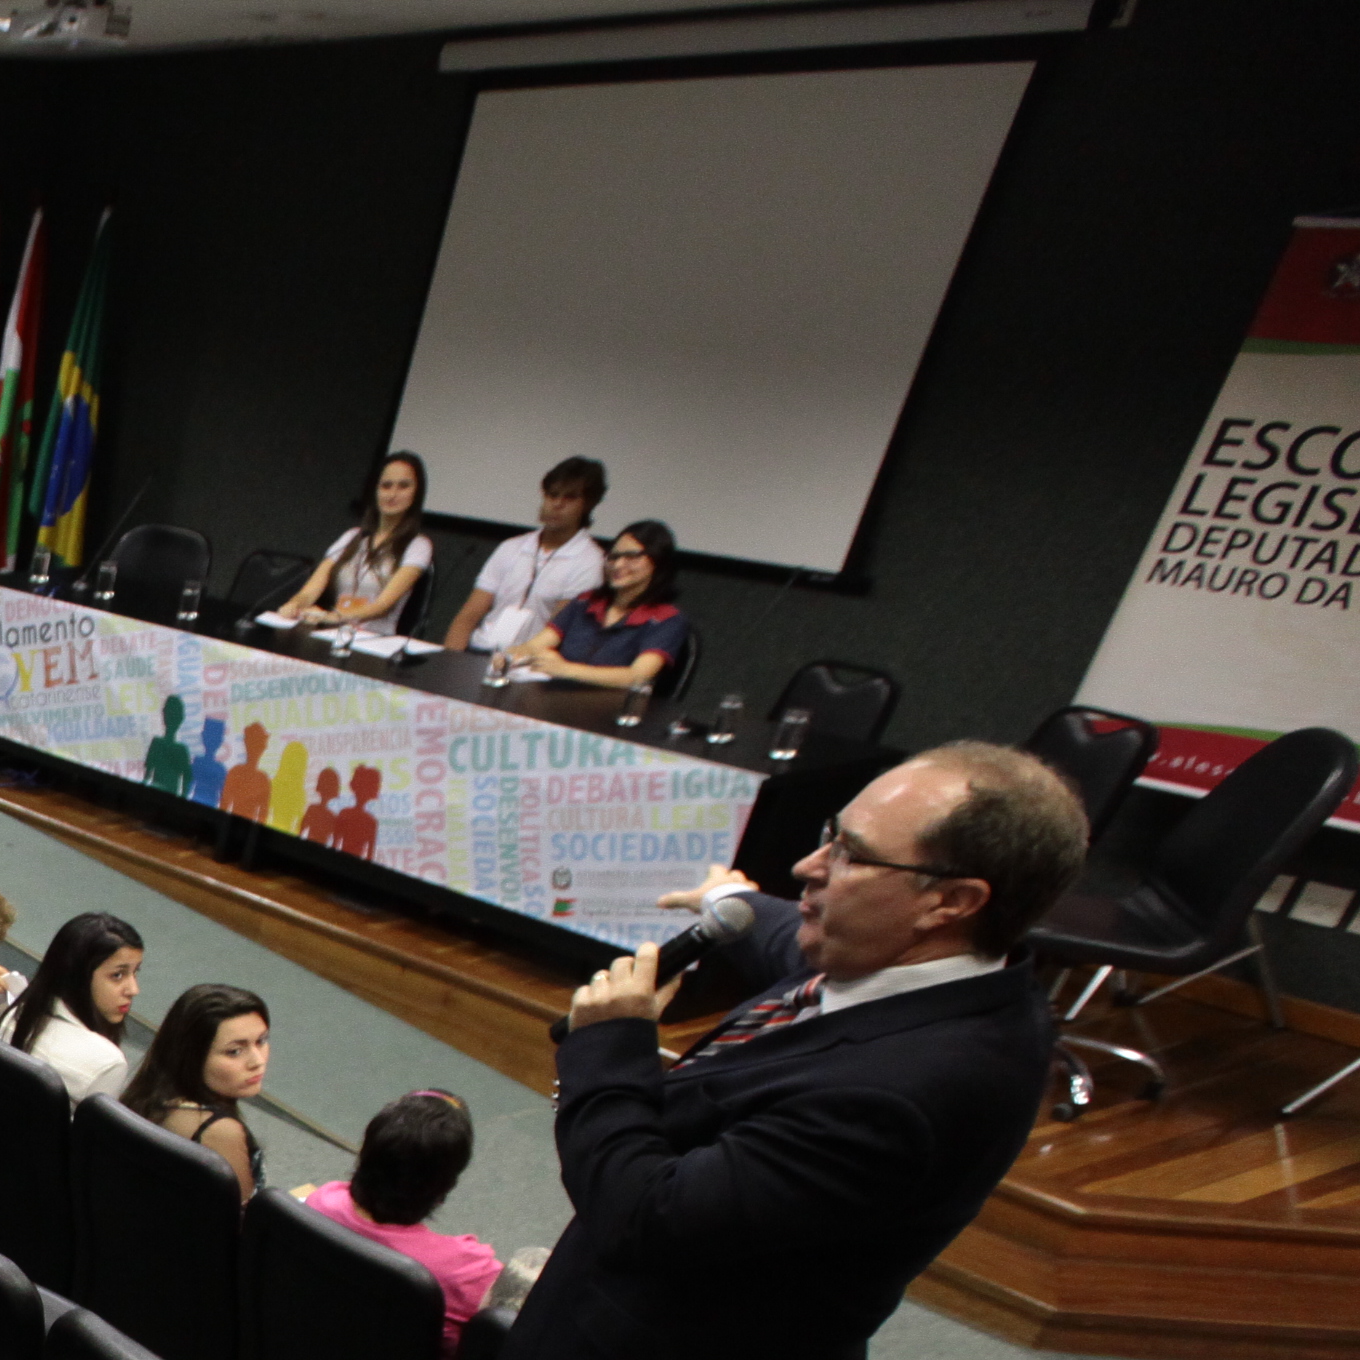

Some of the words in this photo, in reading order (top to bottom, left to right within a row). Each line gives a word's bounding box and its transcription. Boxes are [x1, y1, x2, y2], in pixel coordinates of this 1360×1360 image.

[1145, 557, 1290, 600] MAURO
[1294, 576, 1353, 611] DA
[99, 632, 157, 655] DEBATE
[105, 682, 160, 715] LEIS
[232, 687, 410, 731] IGUALDADE
[448, 729, 636, 774] CULTURA
[414, 692, 448, 881] EMOCRAC
[546, 772, 666, 804] DEBATE
[546, 805, 644, 831] CULTURA
[651, 804, 731, 830] LEIS
[550, 831, 731, 862] SOCIEDADE
